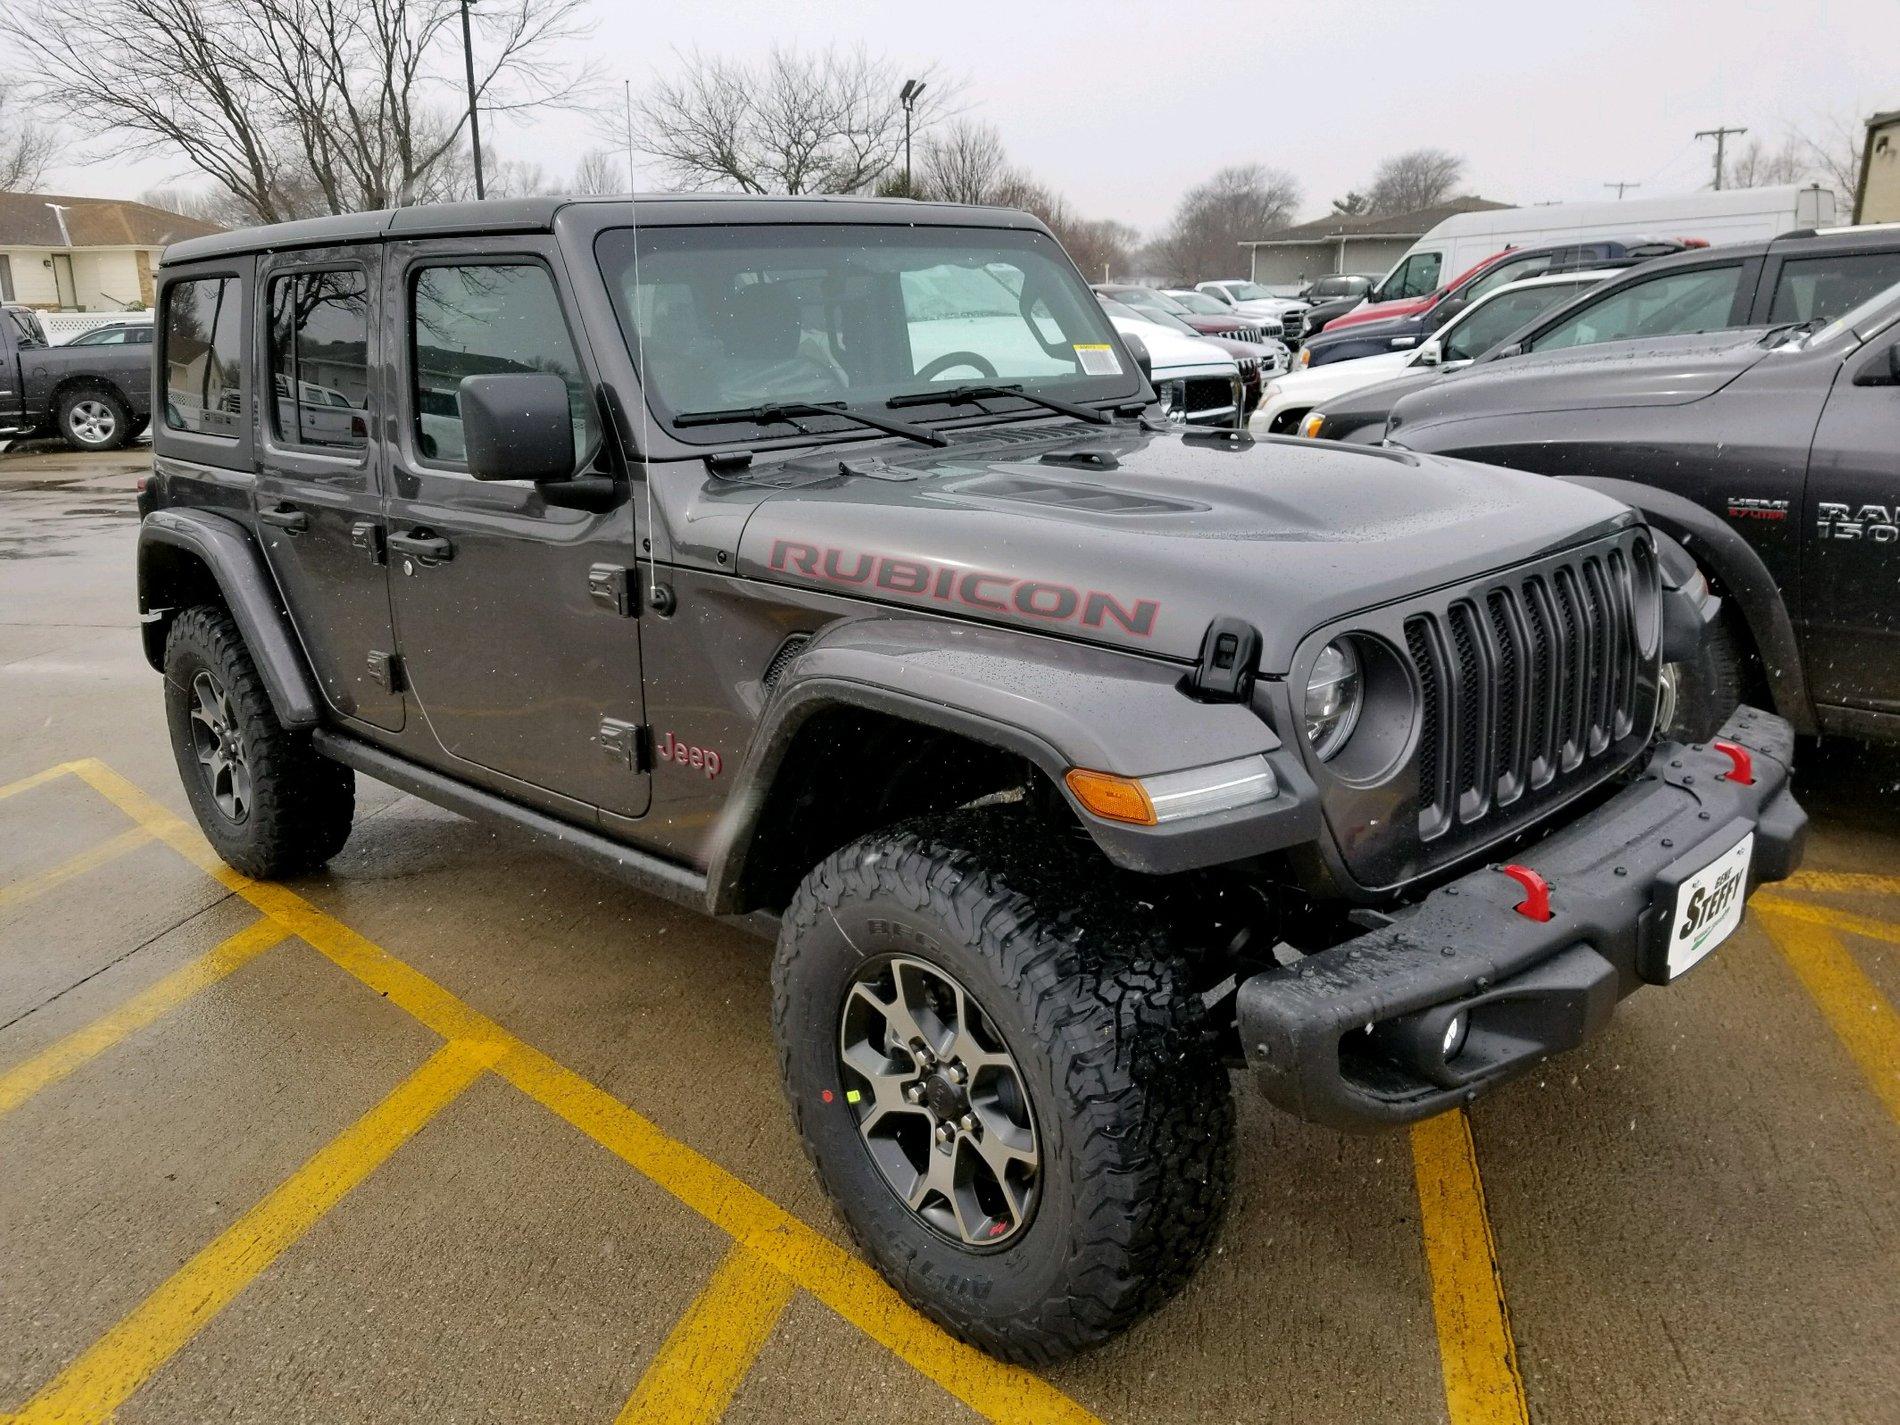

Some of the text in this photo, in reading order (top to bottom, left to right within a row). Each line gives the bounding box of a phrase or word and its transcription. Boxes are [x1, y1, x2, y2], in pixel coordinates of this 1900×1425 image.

[1818, 502, 1900, 523] RA
[769, 538, 1161, 638] RUBICON
[657, 730, 723, 780] Jeep
